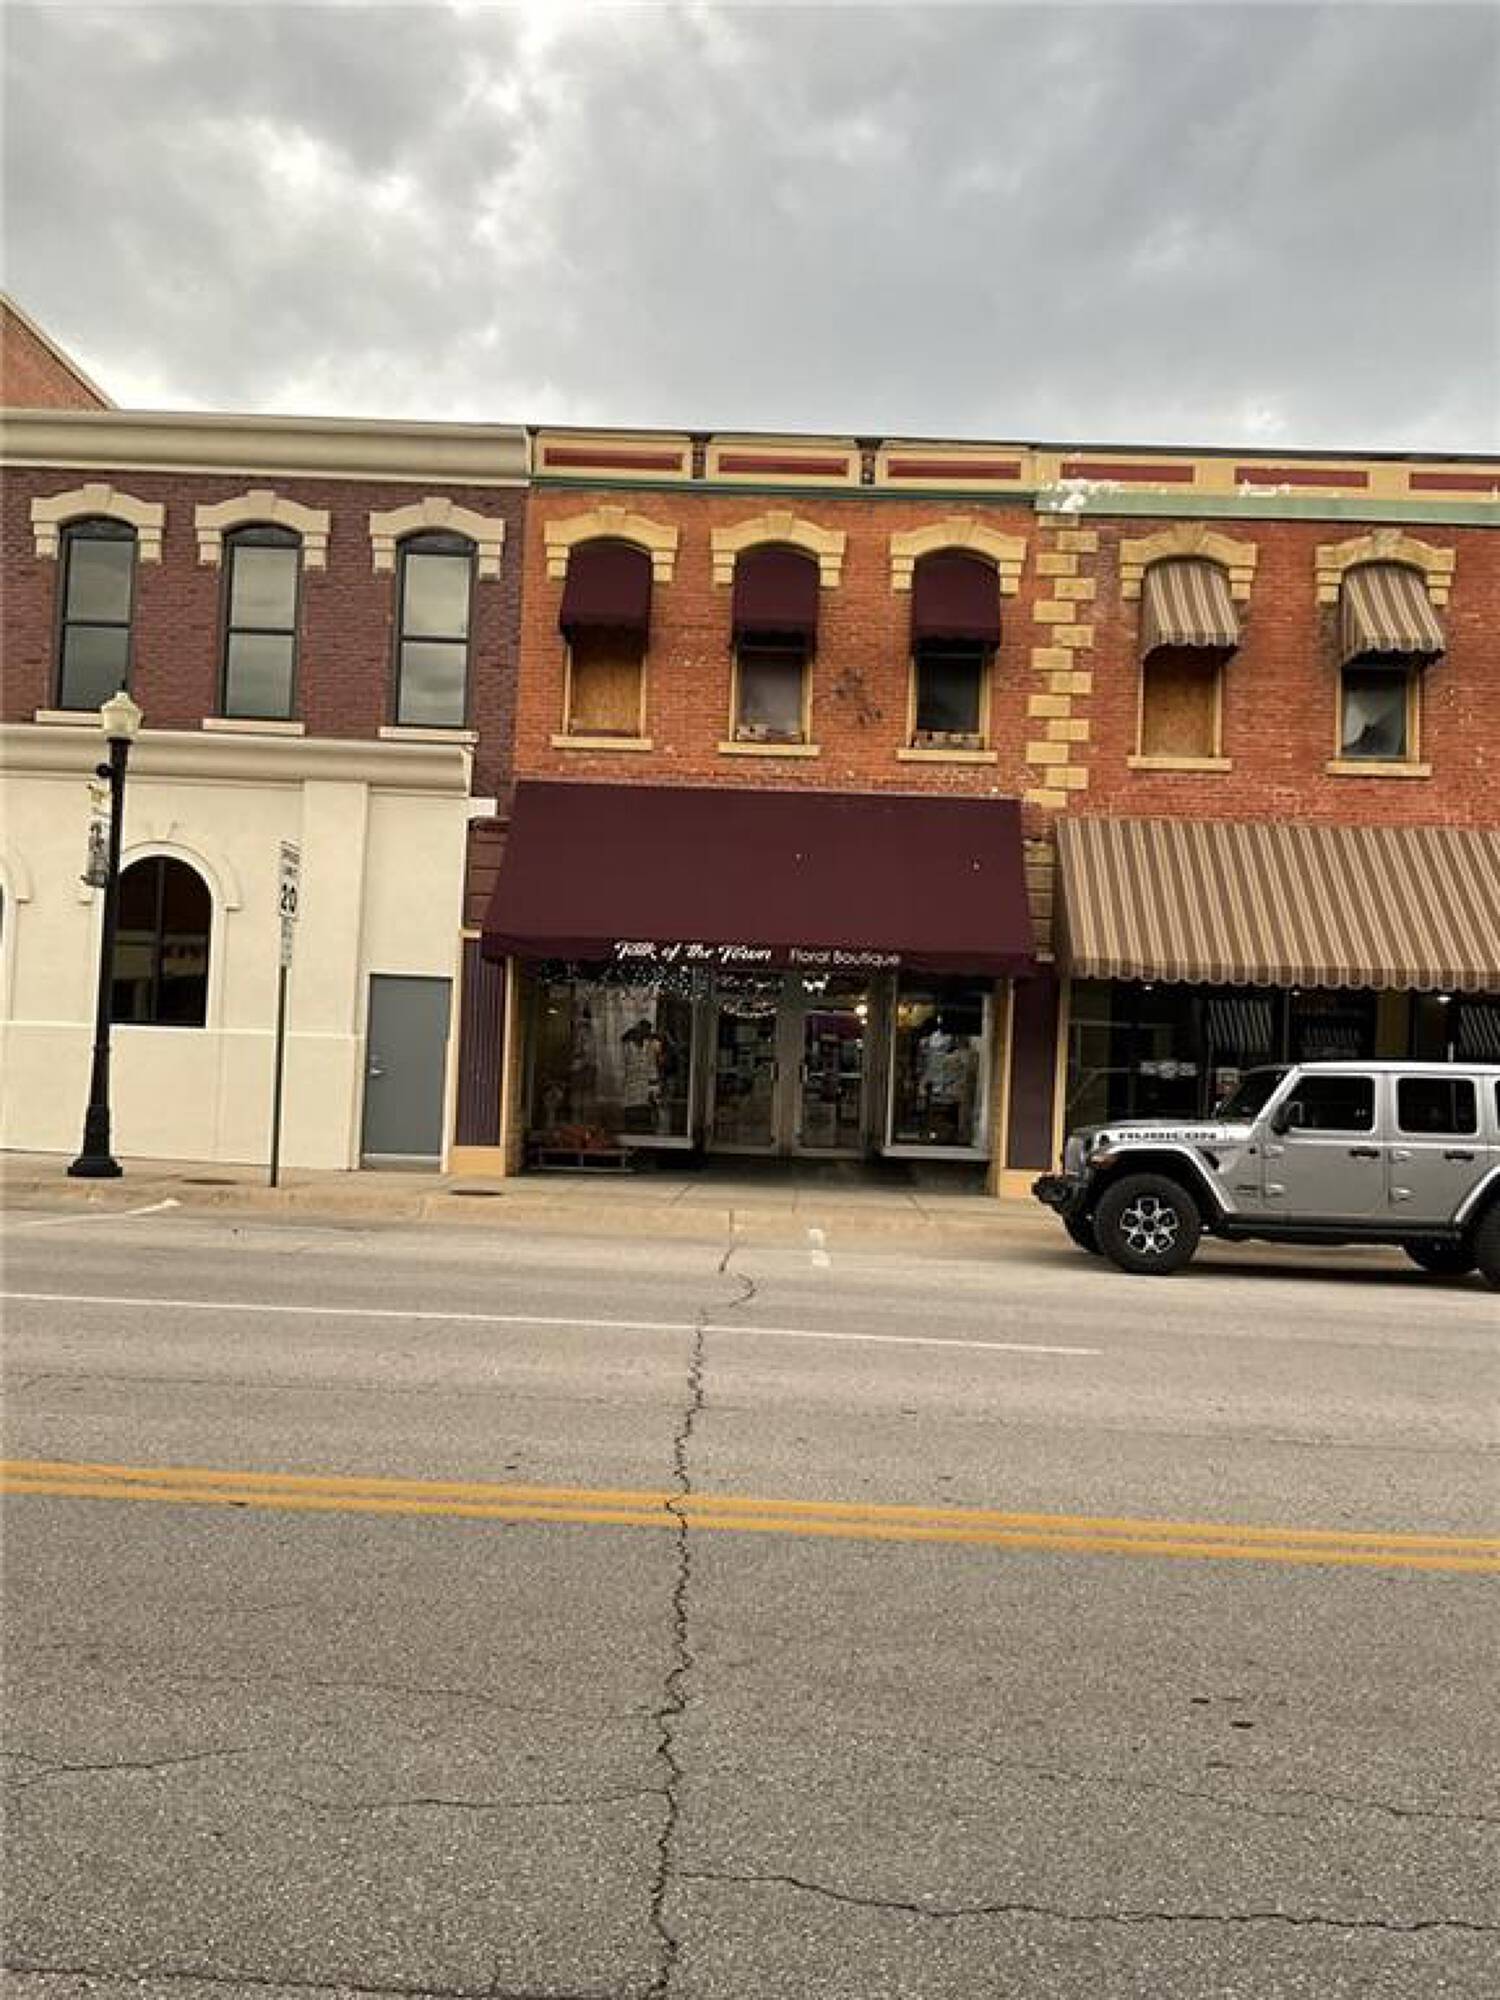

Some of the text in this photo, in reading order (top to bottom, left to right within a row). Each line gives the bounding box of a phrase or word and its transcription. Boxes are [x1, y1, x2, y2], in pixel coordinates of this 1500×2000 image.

[281, 881, 298, 913] 20
[661, 943, 682, 962] of
[790, 947, 900, 968] Floral Boutique
[1118, 1131, 1217, 1141] RUBICON
